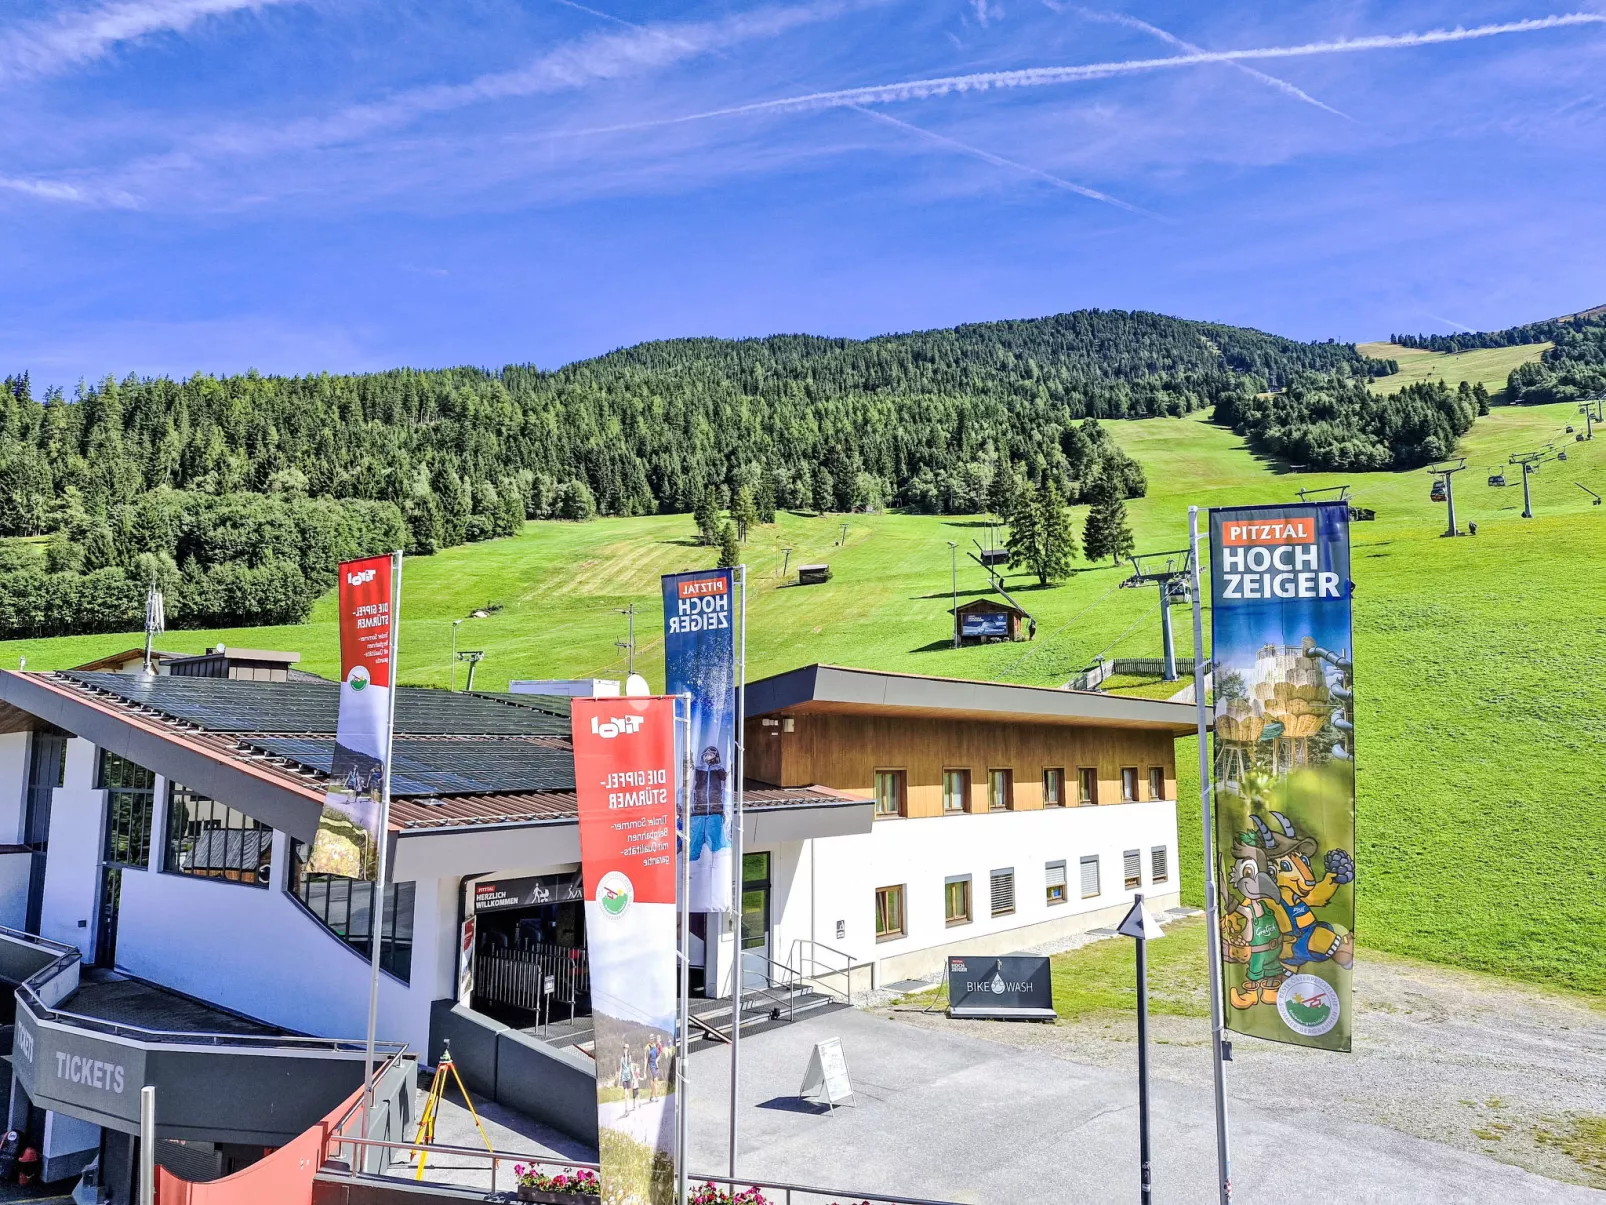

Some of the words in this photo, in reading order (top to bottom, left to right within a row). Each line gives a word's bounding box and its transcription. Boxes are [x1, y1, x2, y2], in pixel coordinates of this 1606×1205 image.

[1230, 523, 1308, 541] PITZTAL
[1223, 545, 1318, 572] HOCH
[1222, 572, 1341, 599] ZEIGER
[476, 891, 507, 901] HERZLICH
[476, 897, 518, 909] WILLKOMMEN
[967, 981, 990, 992] BIKE
[1005, 982, 1033, 992] WASH
[55, 1051, 125, 1094] TICKETS
